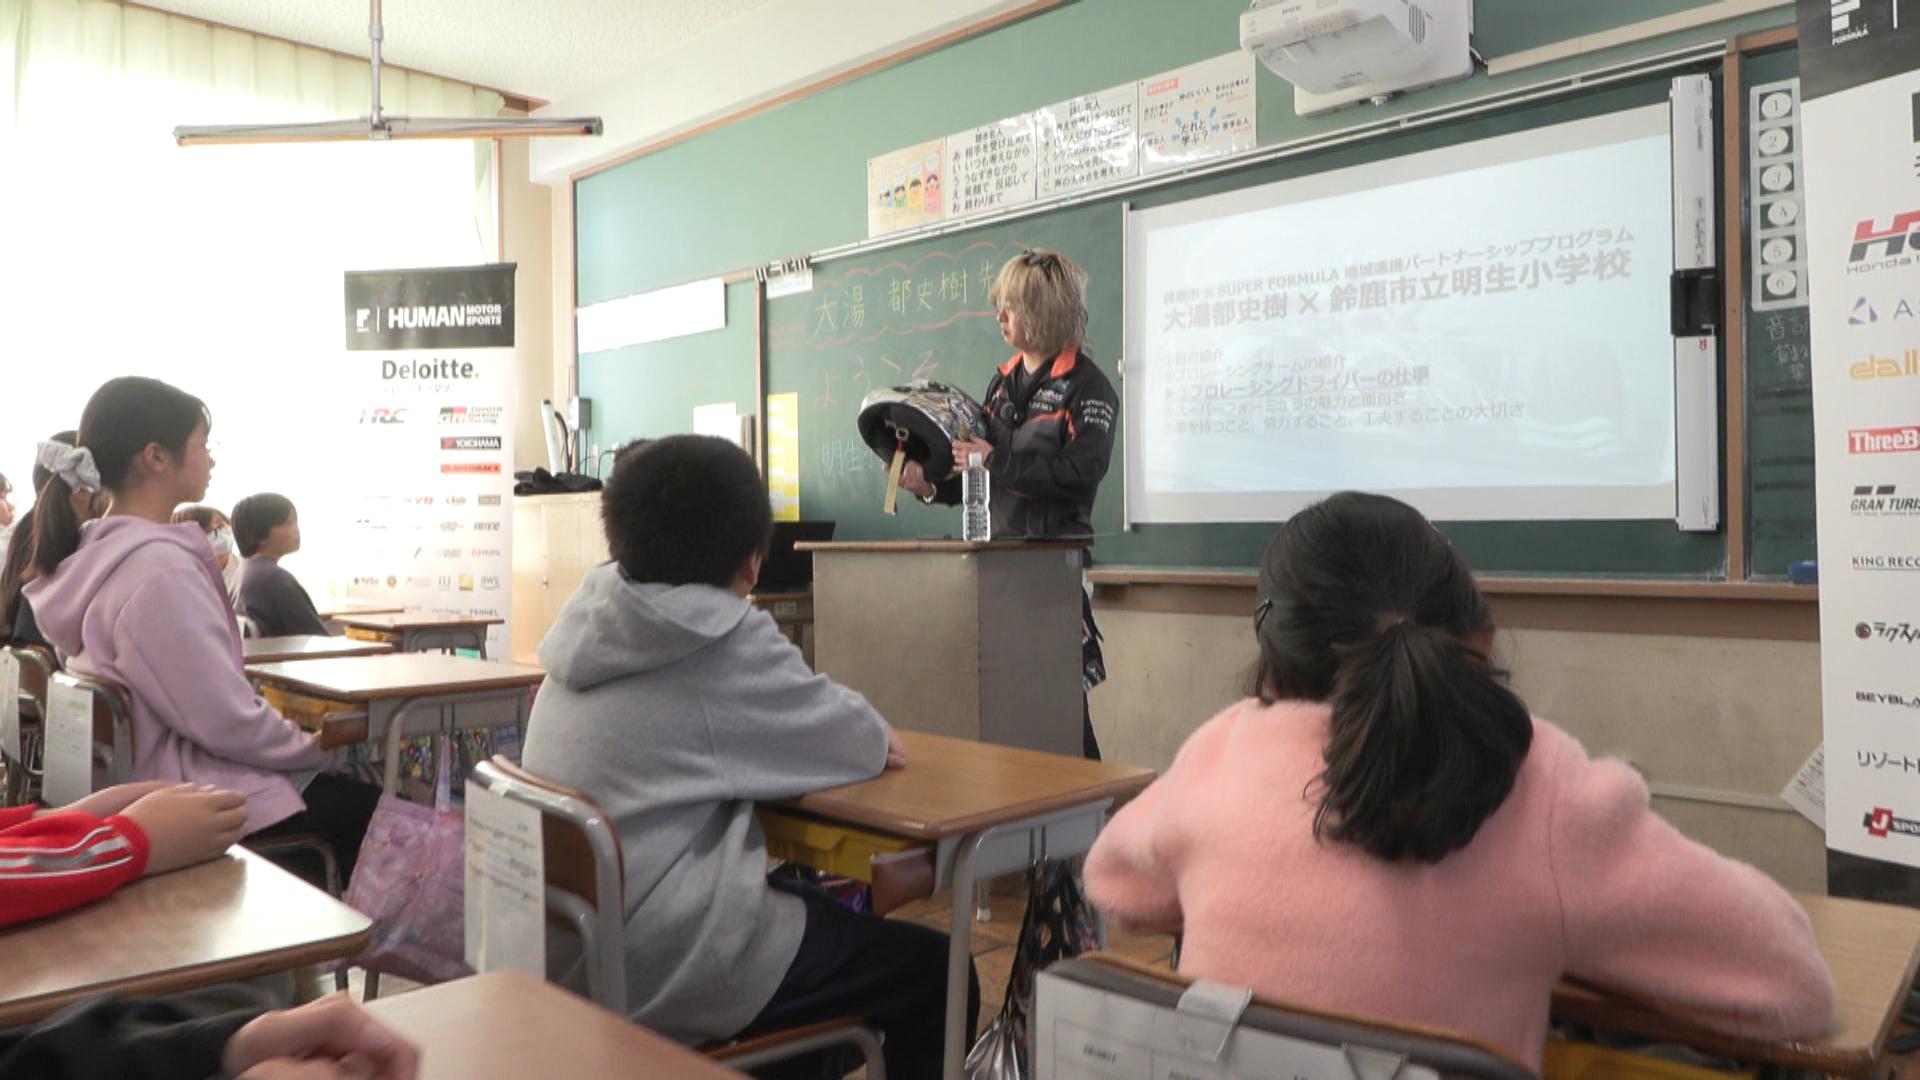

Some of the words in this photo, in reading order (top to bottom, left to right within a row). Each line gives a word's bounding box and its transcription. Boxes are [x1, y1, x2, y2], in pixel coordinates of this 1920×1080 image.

[1846, 256, 1911, 275] Honda
[1217, 280, 1263, 297] SUPER
[1268, 268, 1339, 289] FORMULA
[1330, 248, 1632, 313] 鈴鹿市立明生小学校
[814, 285, 865, 336] 大湯
[888, 267, 969, 316] 都史樹
[388, 306, 465, 329] HUMAN
[466, 304, 502, 315] MOTOR
[466, 315, 502, 327] SPORTS
[382, 358, 480, 380] Deloitte.
[1849, 349, 1920, 380] dall
[455, 437, 500, 448] YOKOHAMA
[1851, 429, 1920, 453] ThreeB
[1850, 498, 1885, 511] GRAN
[1888, 498, 1920, 510] TURI
[1852, 556, 1885, 568] KING
[1893, 820, 1920, 834] SPO
